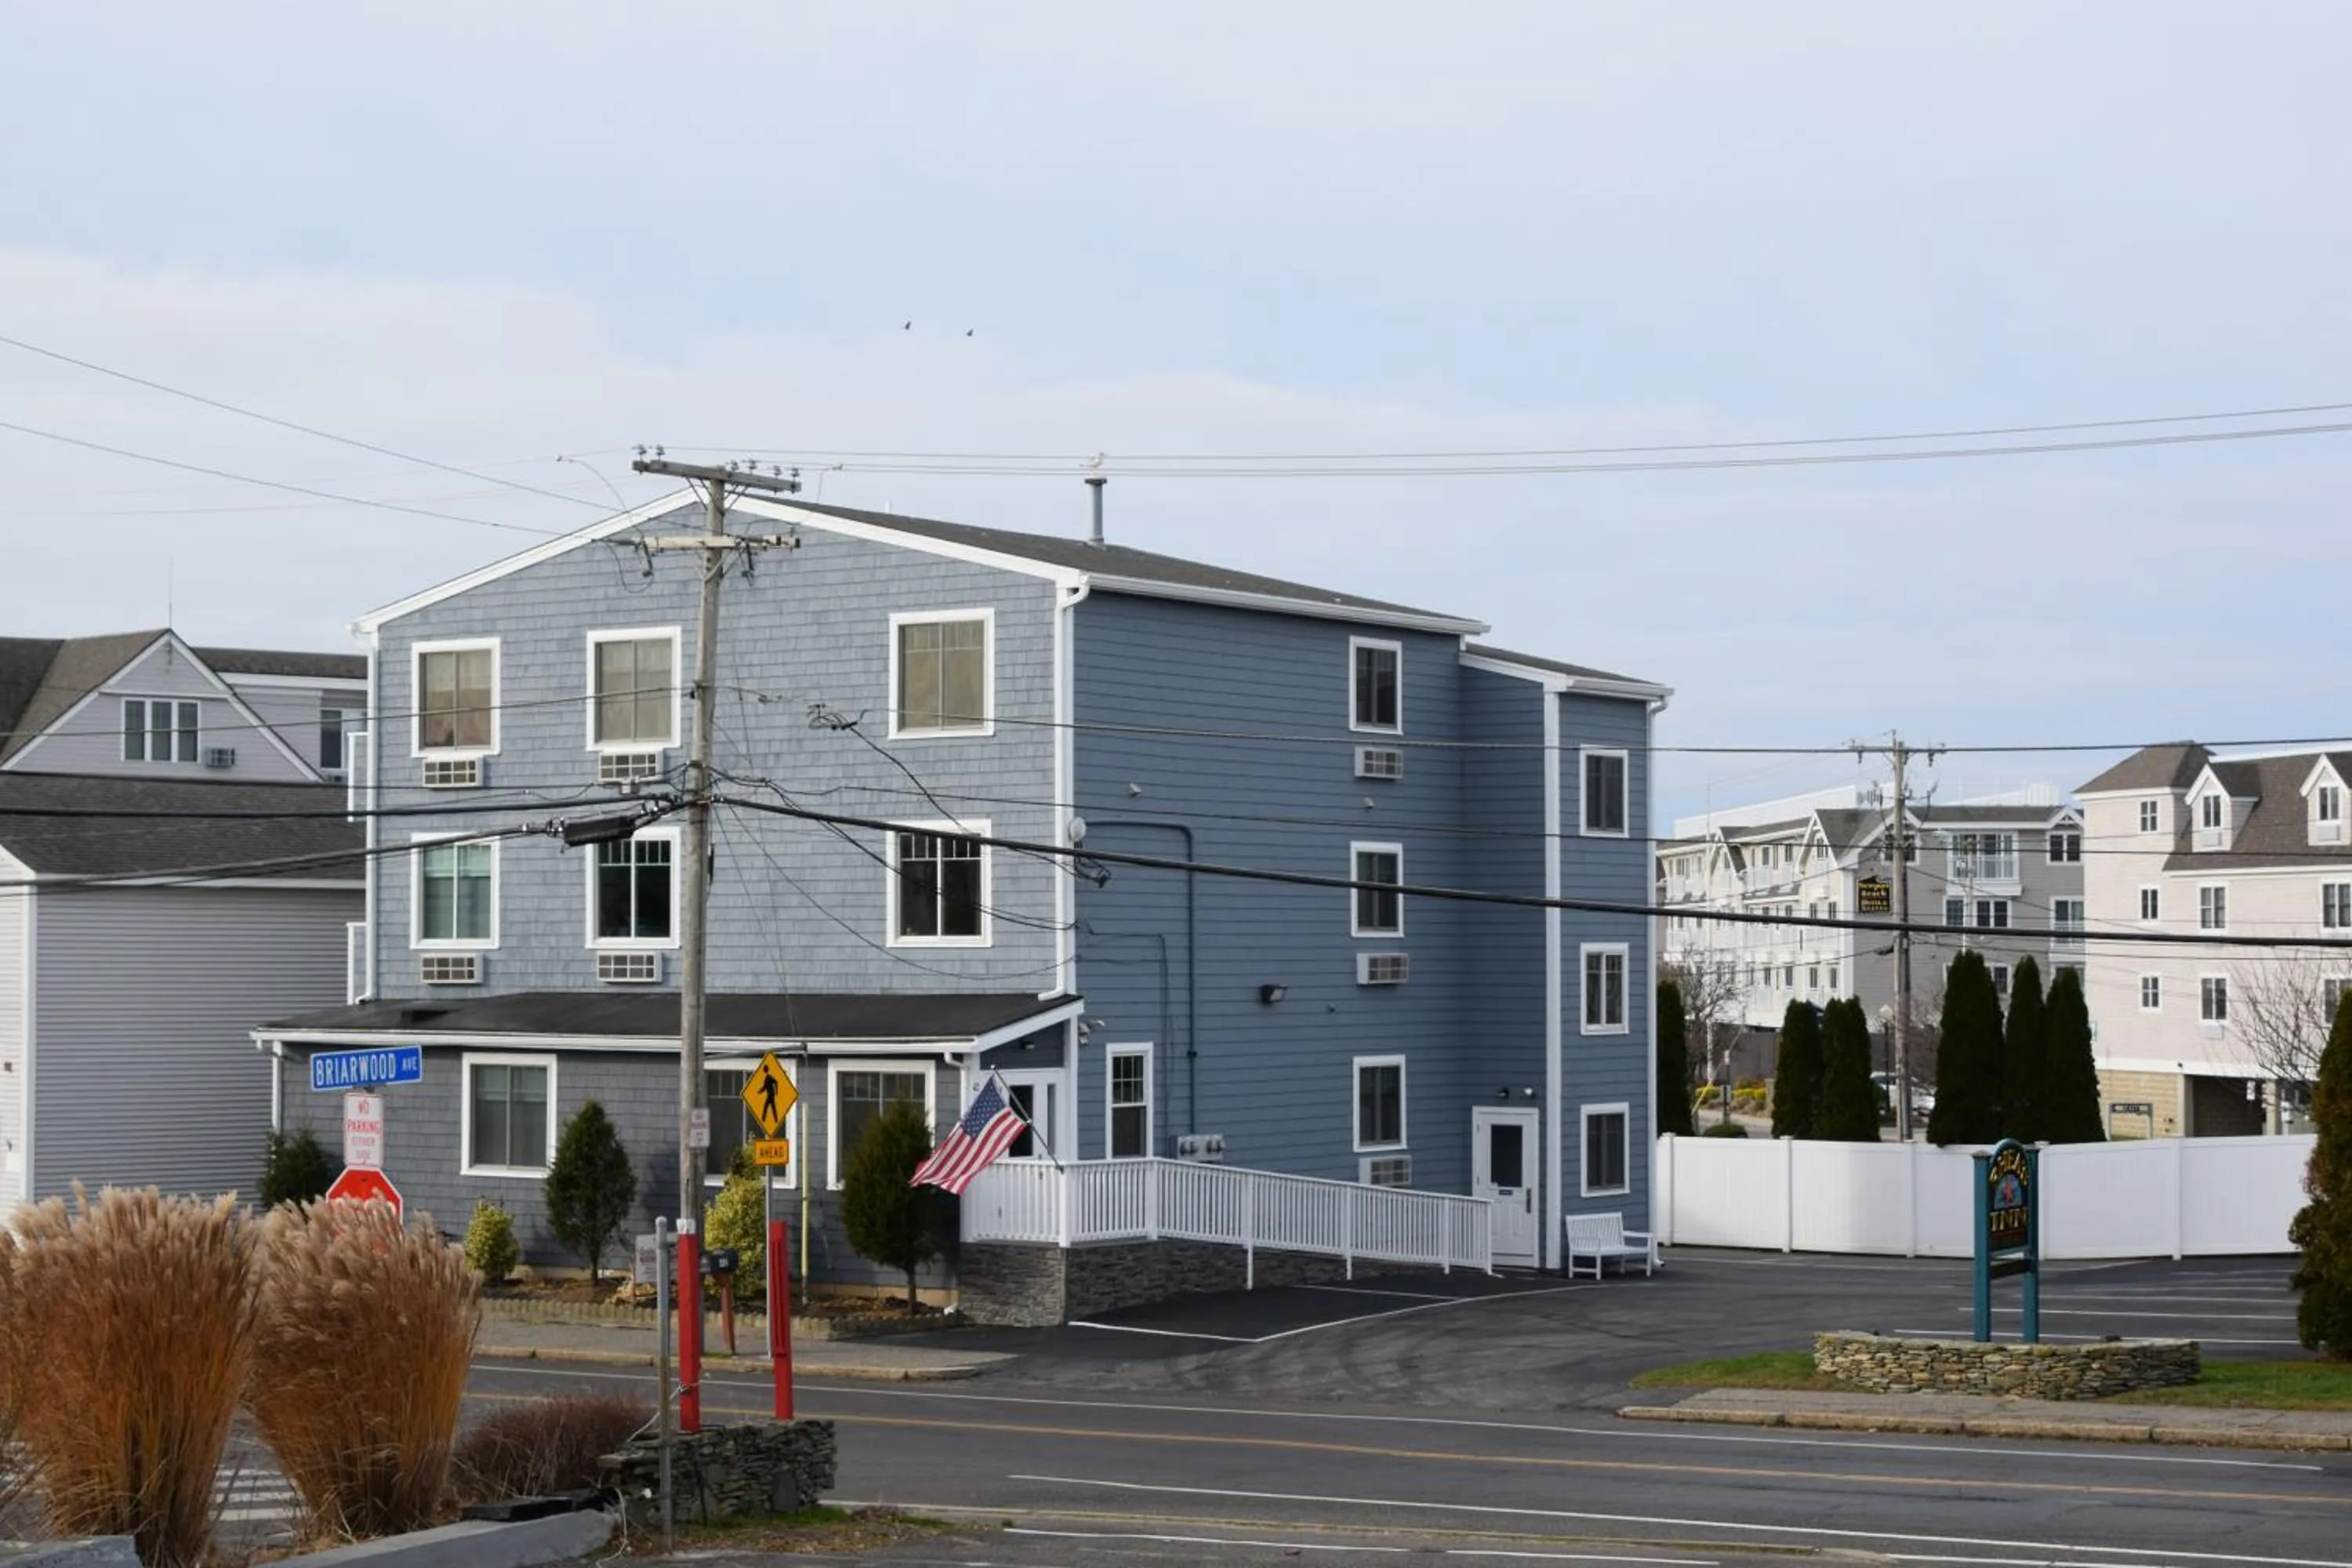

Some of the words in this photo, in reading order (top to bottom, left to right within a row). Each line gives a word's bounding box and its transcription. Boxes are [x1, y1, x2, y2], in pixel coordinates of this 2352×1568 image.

[316, 1054, 396, 1085] BRIARWOOD
[401, 1056, 417, 1071] AVE
[358, 1101, 370, 1115] NO
[347, 1120, 380, 1134] PARKING
[759, 1145, 783, 1159] AHEAD
[1990, 1207, 2027, 1231] INN
